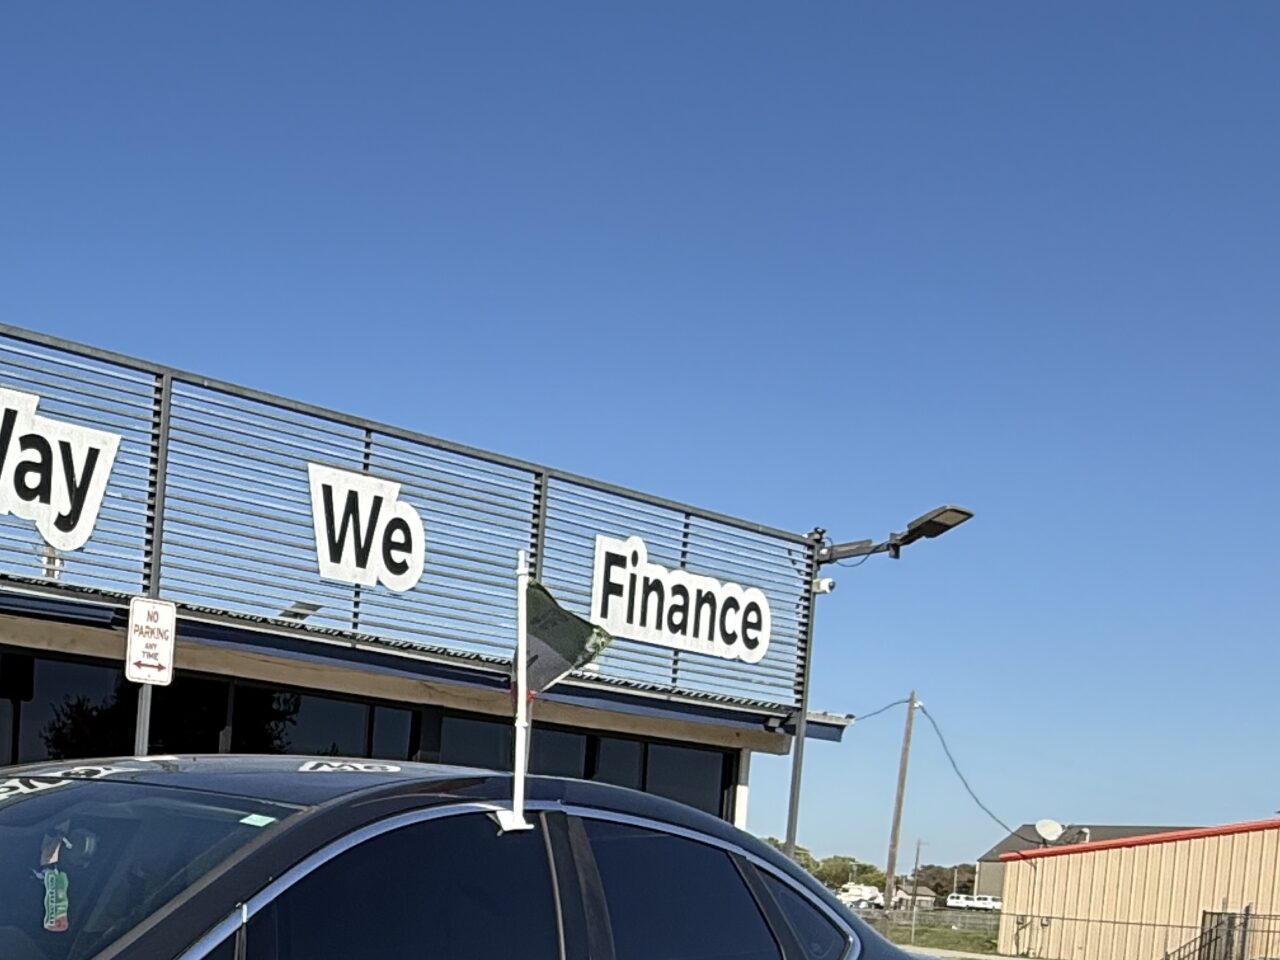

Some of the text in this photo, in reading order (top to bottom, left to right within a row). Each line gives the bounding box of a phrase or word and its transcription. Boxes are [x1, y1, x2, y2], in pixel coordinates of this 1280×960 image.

[321, 483, 413, 576] We
[600, 549, 763, 650] Finance
[146, 610, 159, 623] NO
[133, 624, 170, 641] PARKING
[144, 642, 158, 650] ANY
[141, 651, 160, 661] TIME
